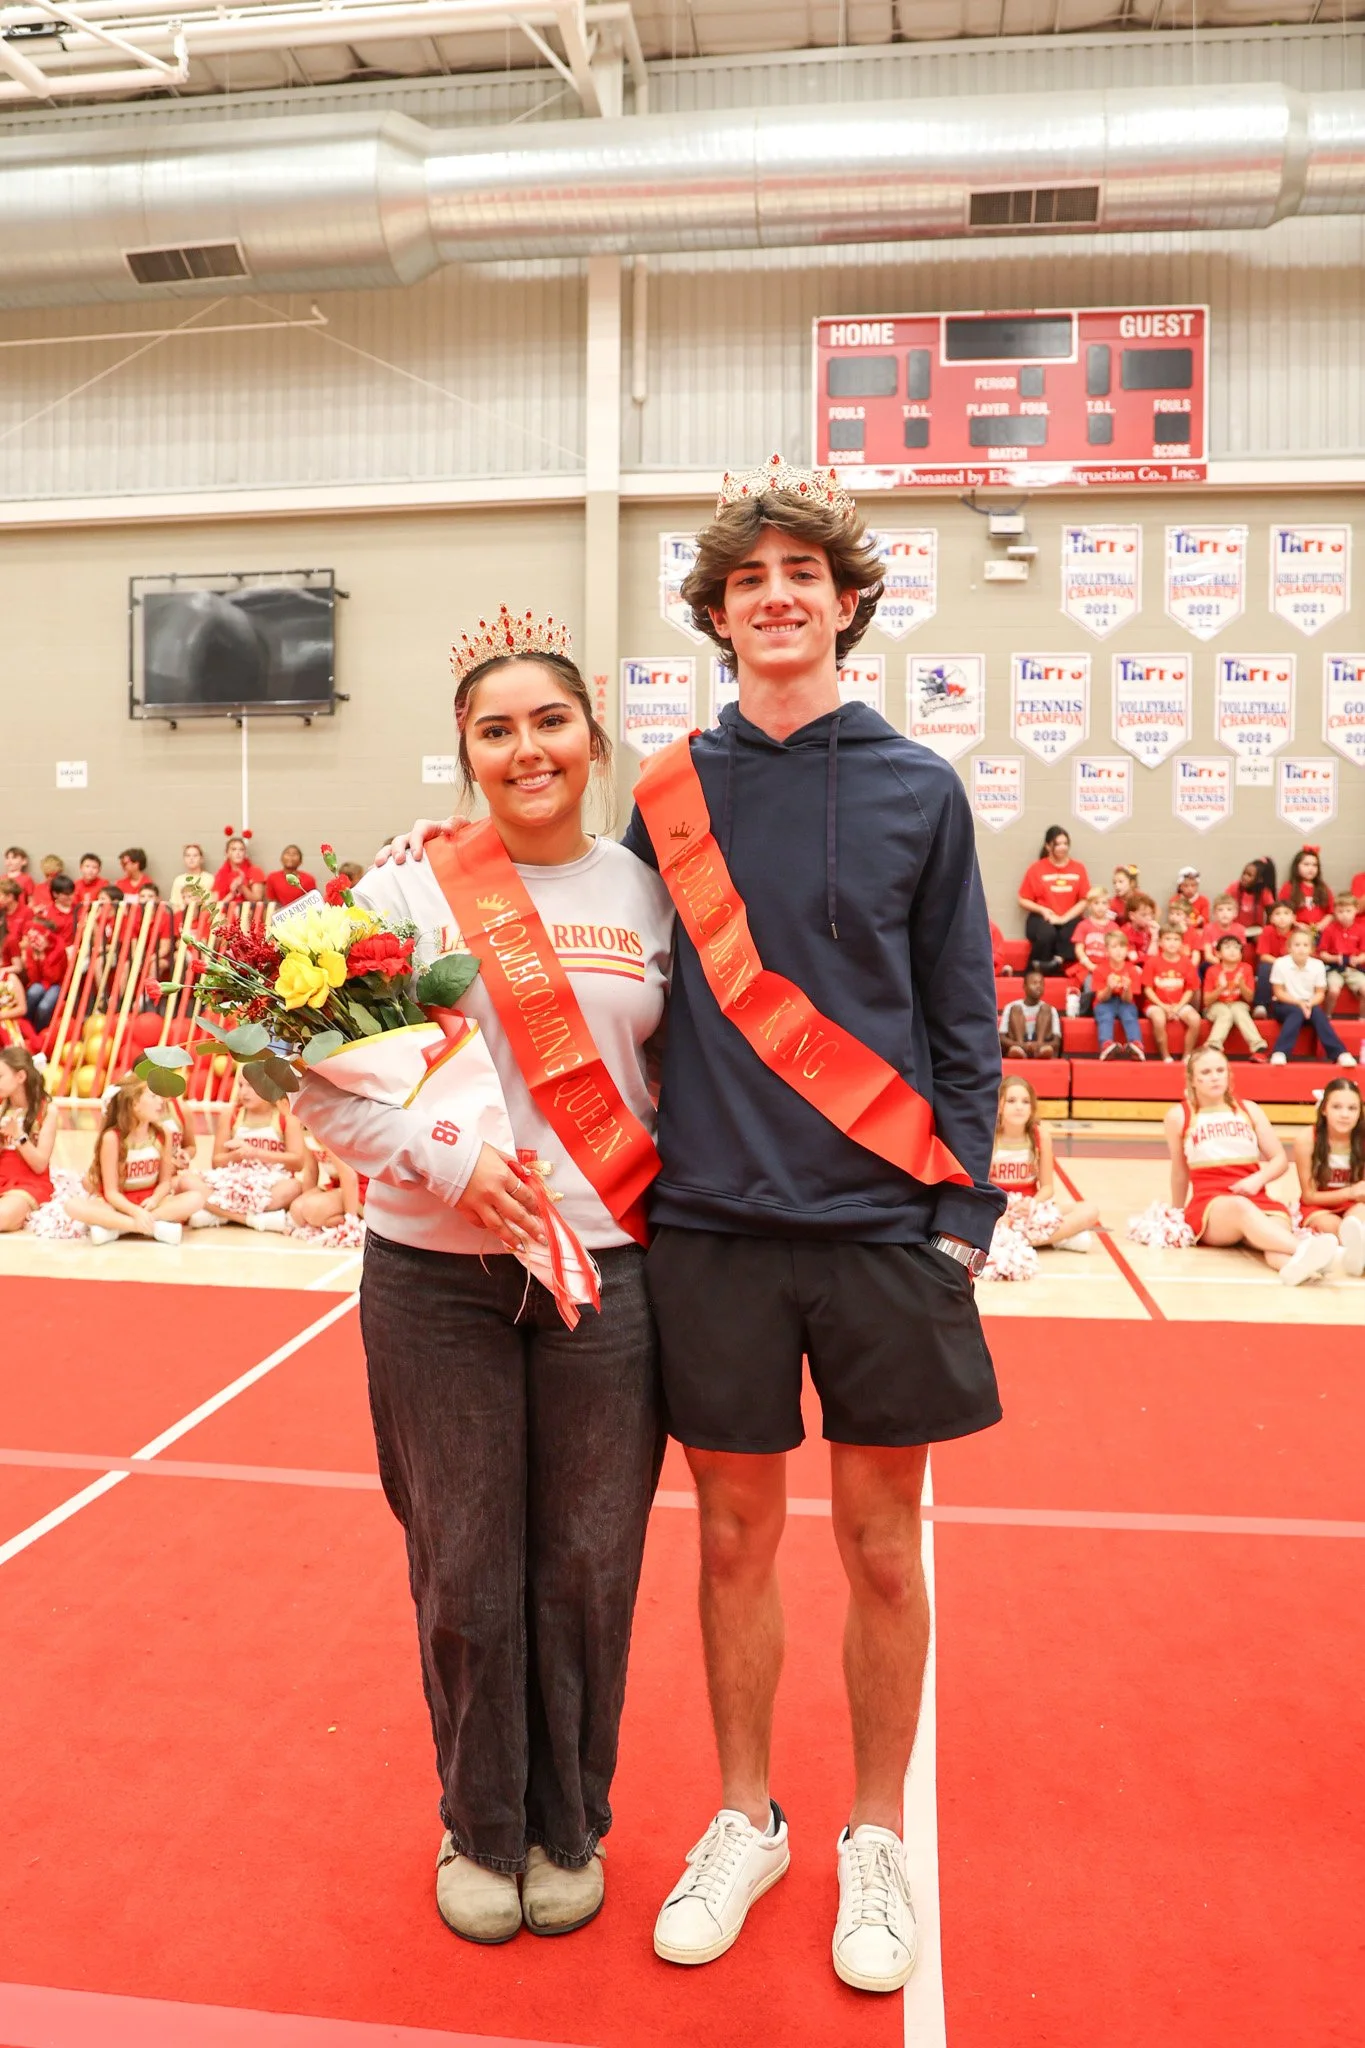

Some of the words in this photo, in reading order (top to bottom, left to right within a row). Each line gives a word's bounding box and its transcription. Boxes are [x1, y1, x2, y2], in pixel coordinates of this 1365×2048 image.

[1119, 314, 1196, 339] GUEST
[829, 322, 896, 347] HOME
[974, 377, 1018, 391] PERIOD
[828, 406, 866, 420] FOULS
[966, 402, 1011, 417] PLAYER
[1019, 402, 1050, 416] FOUL
[1153, 398, 1192, 413] FOULS
[827, 450, 866, 465] SCORE
[987, 447, 1029, 461] MATCH
[1152, 443, 1192, 458] SCORE
[903, 469, 964, 485] Donated
[967, 470, 986, 488] by
[1171, 465, 1201, 480] Inc.
[880, 604, 914, 617] 2020
[1018, 700, 1083, 713] TENNIS
[913, 723, 977, 737] CHAMPION
[551, 923, 645, 957] RRIORS
[481, 907, 584, 1078] HOMECOMING
[551, 1070, 634, 1163] QUEEN
[1190, 1121, 1254, 1146] WARRIORS
